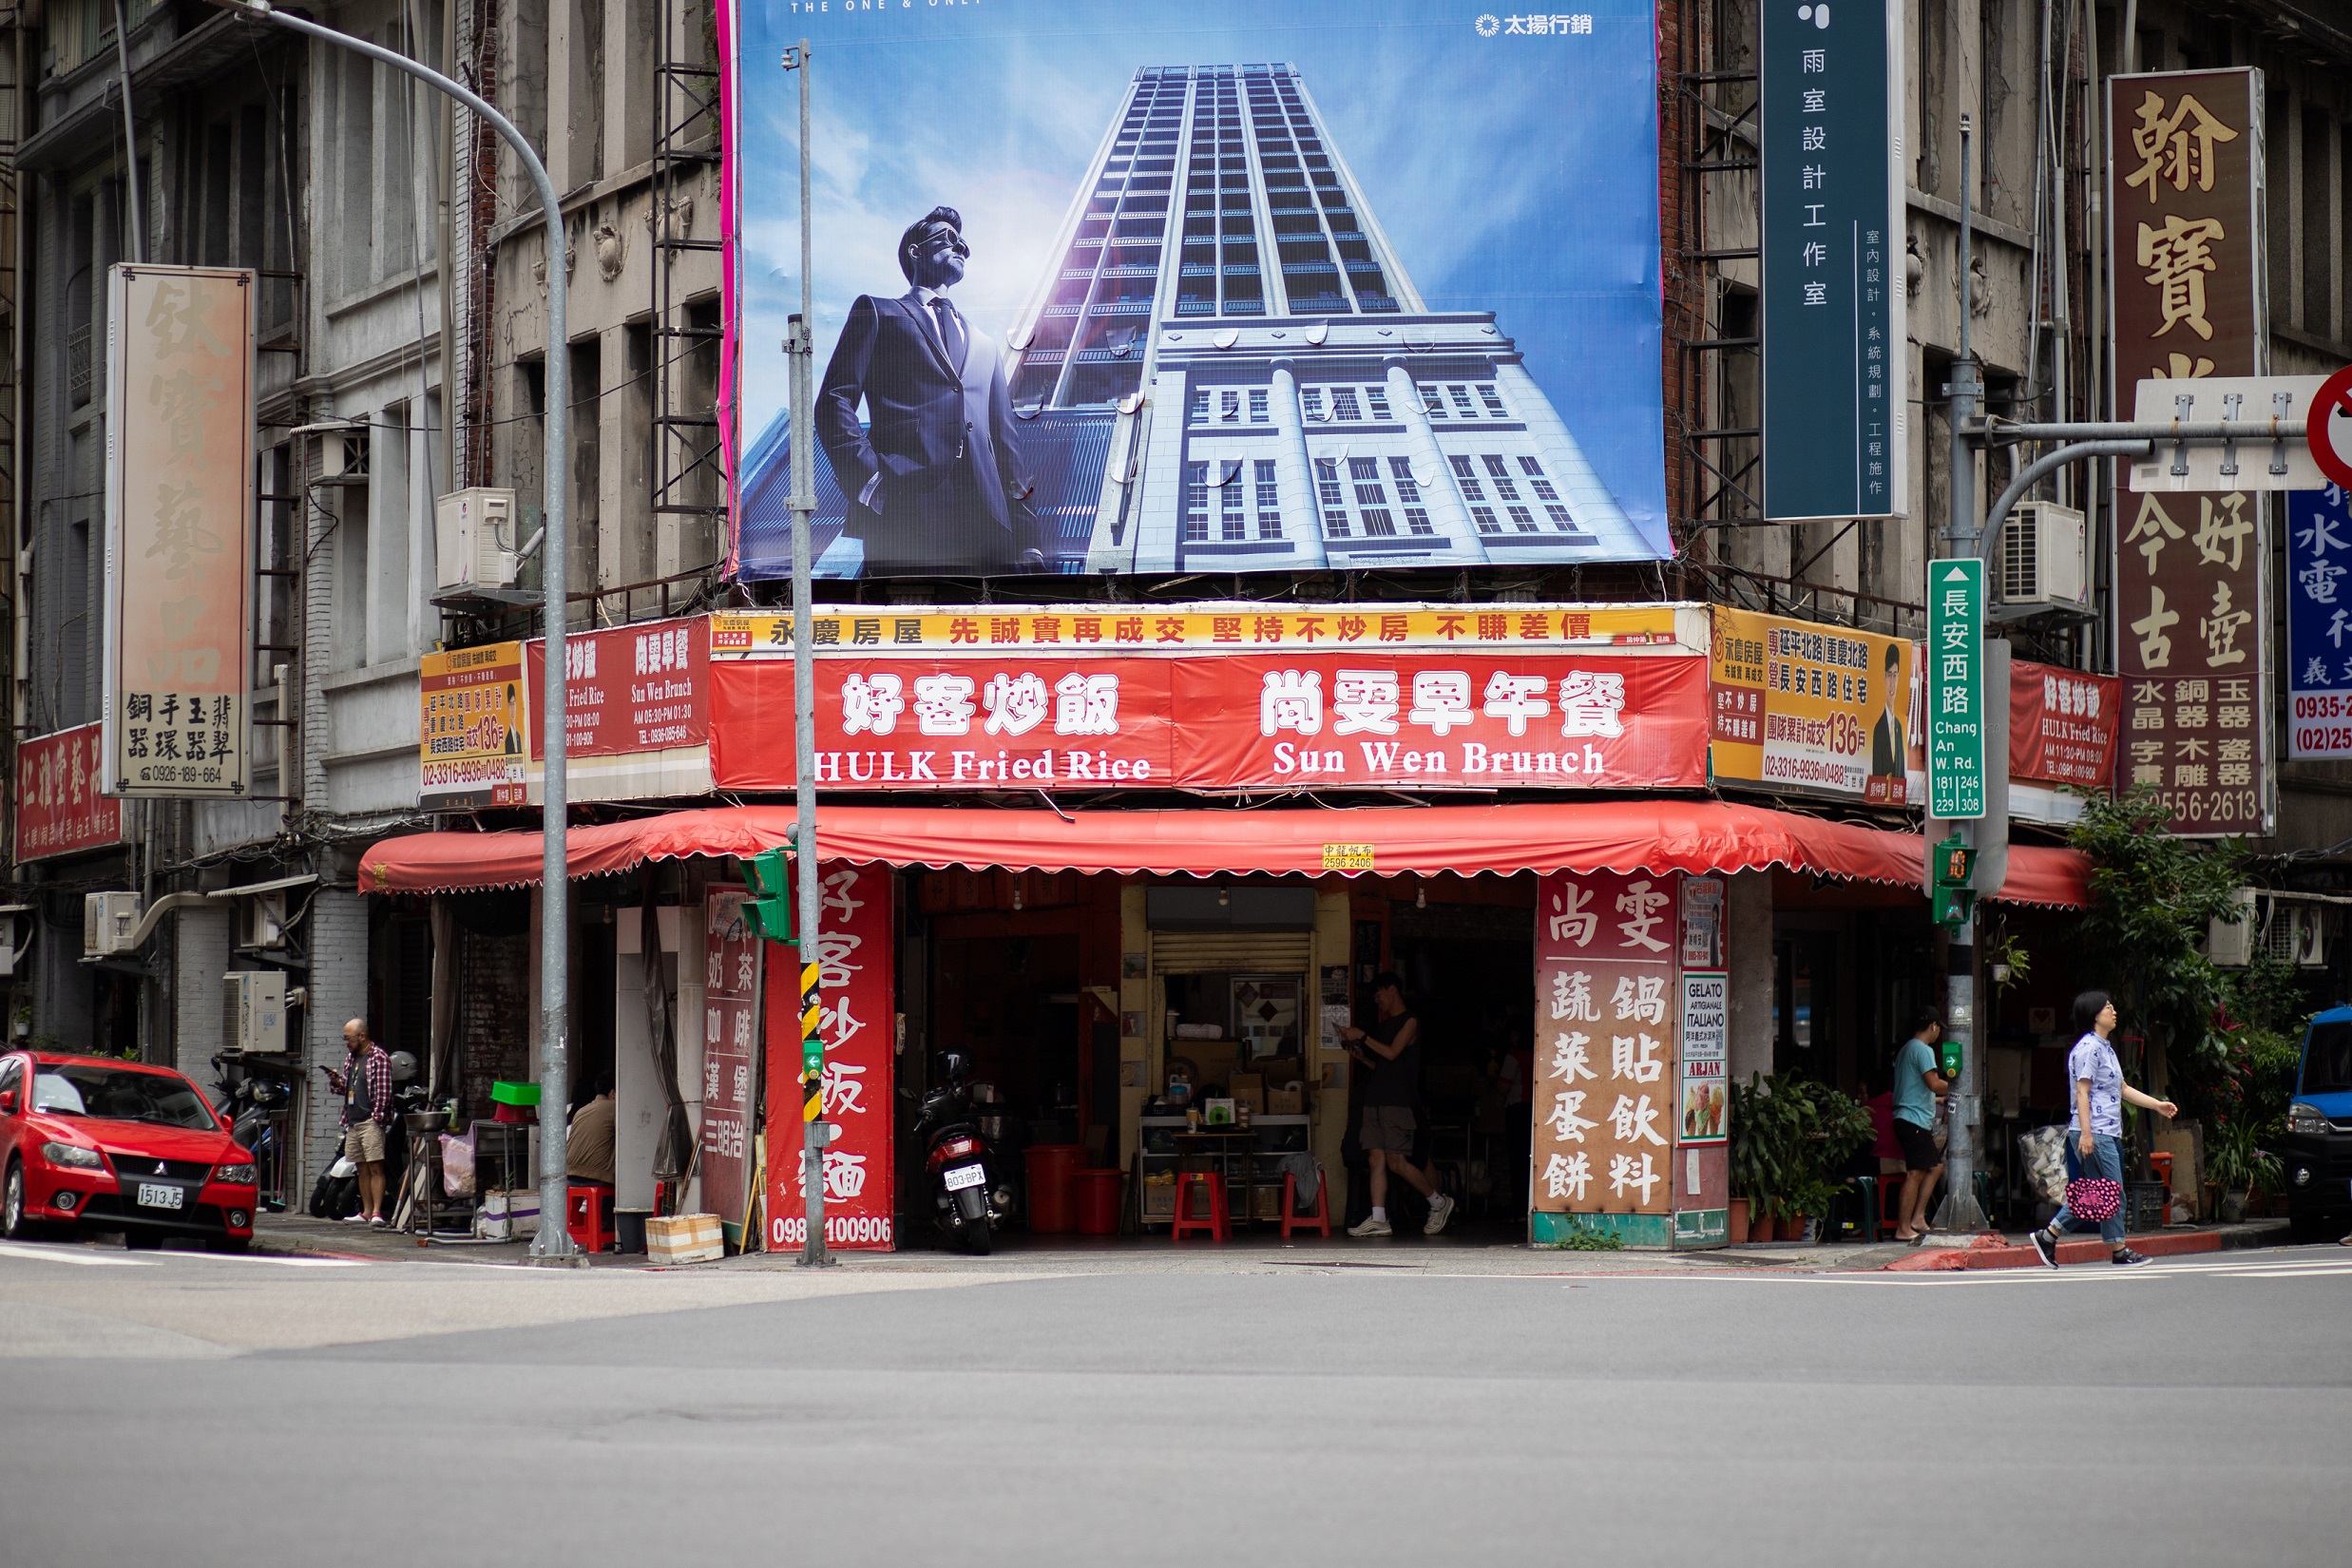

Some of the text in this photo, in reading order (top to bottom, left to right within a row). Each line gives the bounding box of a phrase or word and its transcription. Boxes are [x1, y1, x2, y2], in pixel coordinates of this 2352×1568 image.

[791, 3, 829, 13] THE
[846, 0, 885, 10] ONE
[1504, 13, 1593, 35] 太揚行銷
[1802, 48, 1826, 306] 雨室設計工作室
[2124, 89, 2241, 379] 翰寶
[771, 613, 1592, 645] 永慶房屋 先誠實再成交 堅持不炒房 不賺差價
[565, 639, 597, 680] 炒飯
[1725, 637, 1764, 666] 永慶房屋
[1941, 589, 1969, 715] 長安西路
[631, 677, 692, 703] Sun Wen Brunch
[1779, 663, 1867, 705] 長安西路住宅
[569, 687, 604, 707] Fried Rice
[842, 672, 1119, 736] 好客炒飯
[1260, 669, 1625, 737] 尚雯早午餐
[1725, 690, 1757, 713] 不炒房
[2043, 674, 2100, 719] 好客炒飯
[566, 712, 600, 728] 30-PM 08:00
[634, 711, 643, 724] AM
[673, 704, 692, 719] 01:30
[1936, 721, 1977, 737] Chang
[2042, 717, 2108, 745] HULK Fried Rice
[1936, 739, 1955, 752] An
[2044, 742, 2055, 756] AM
[814, 749, 1151, 782] HULK Fried Rice
[1272, 742, 1606, 774] Sun Wen Brunch
[1936, 757, 1975, 770] W. Rd.
[153, 765, 221, 783] 0926-189-664
[1936, 775, 1953, 790] 181
[1960, 775, 1979, 790] 246
[1936, 798, 1954, 813] 229
[1961, 798, 1979, 813] 308
[1325, 845, 1372, 856] 中龍帆布
[1549, 879, 1671, 952] 尚雯
[708, 951, 754, 991] 奶茶
[1689, 983, 1722, 998] GELATO
[1690, 1001, 1722, 1009] ARTIGIANALE
[707, 1007, 751, 1046] 咖啡
[1687, 1013, 1724, 1027] ITALIANO
[1688, 1061, 1721, 1077] ARJAN
[706, 1061, 749, 1102] 漢堡
[1541, 970, 1601, 1201] 蔬菜蛋餅
[705, 1119, 744, 1159] 三明治
